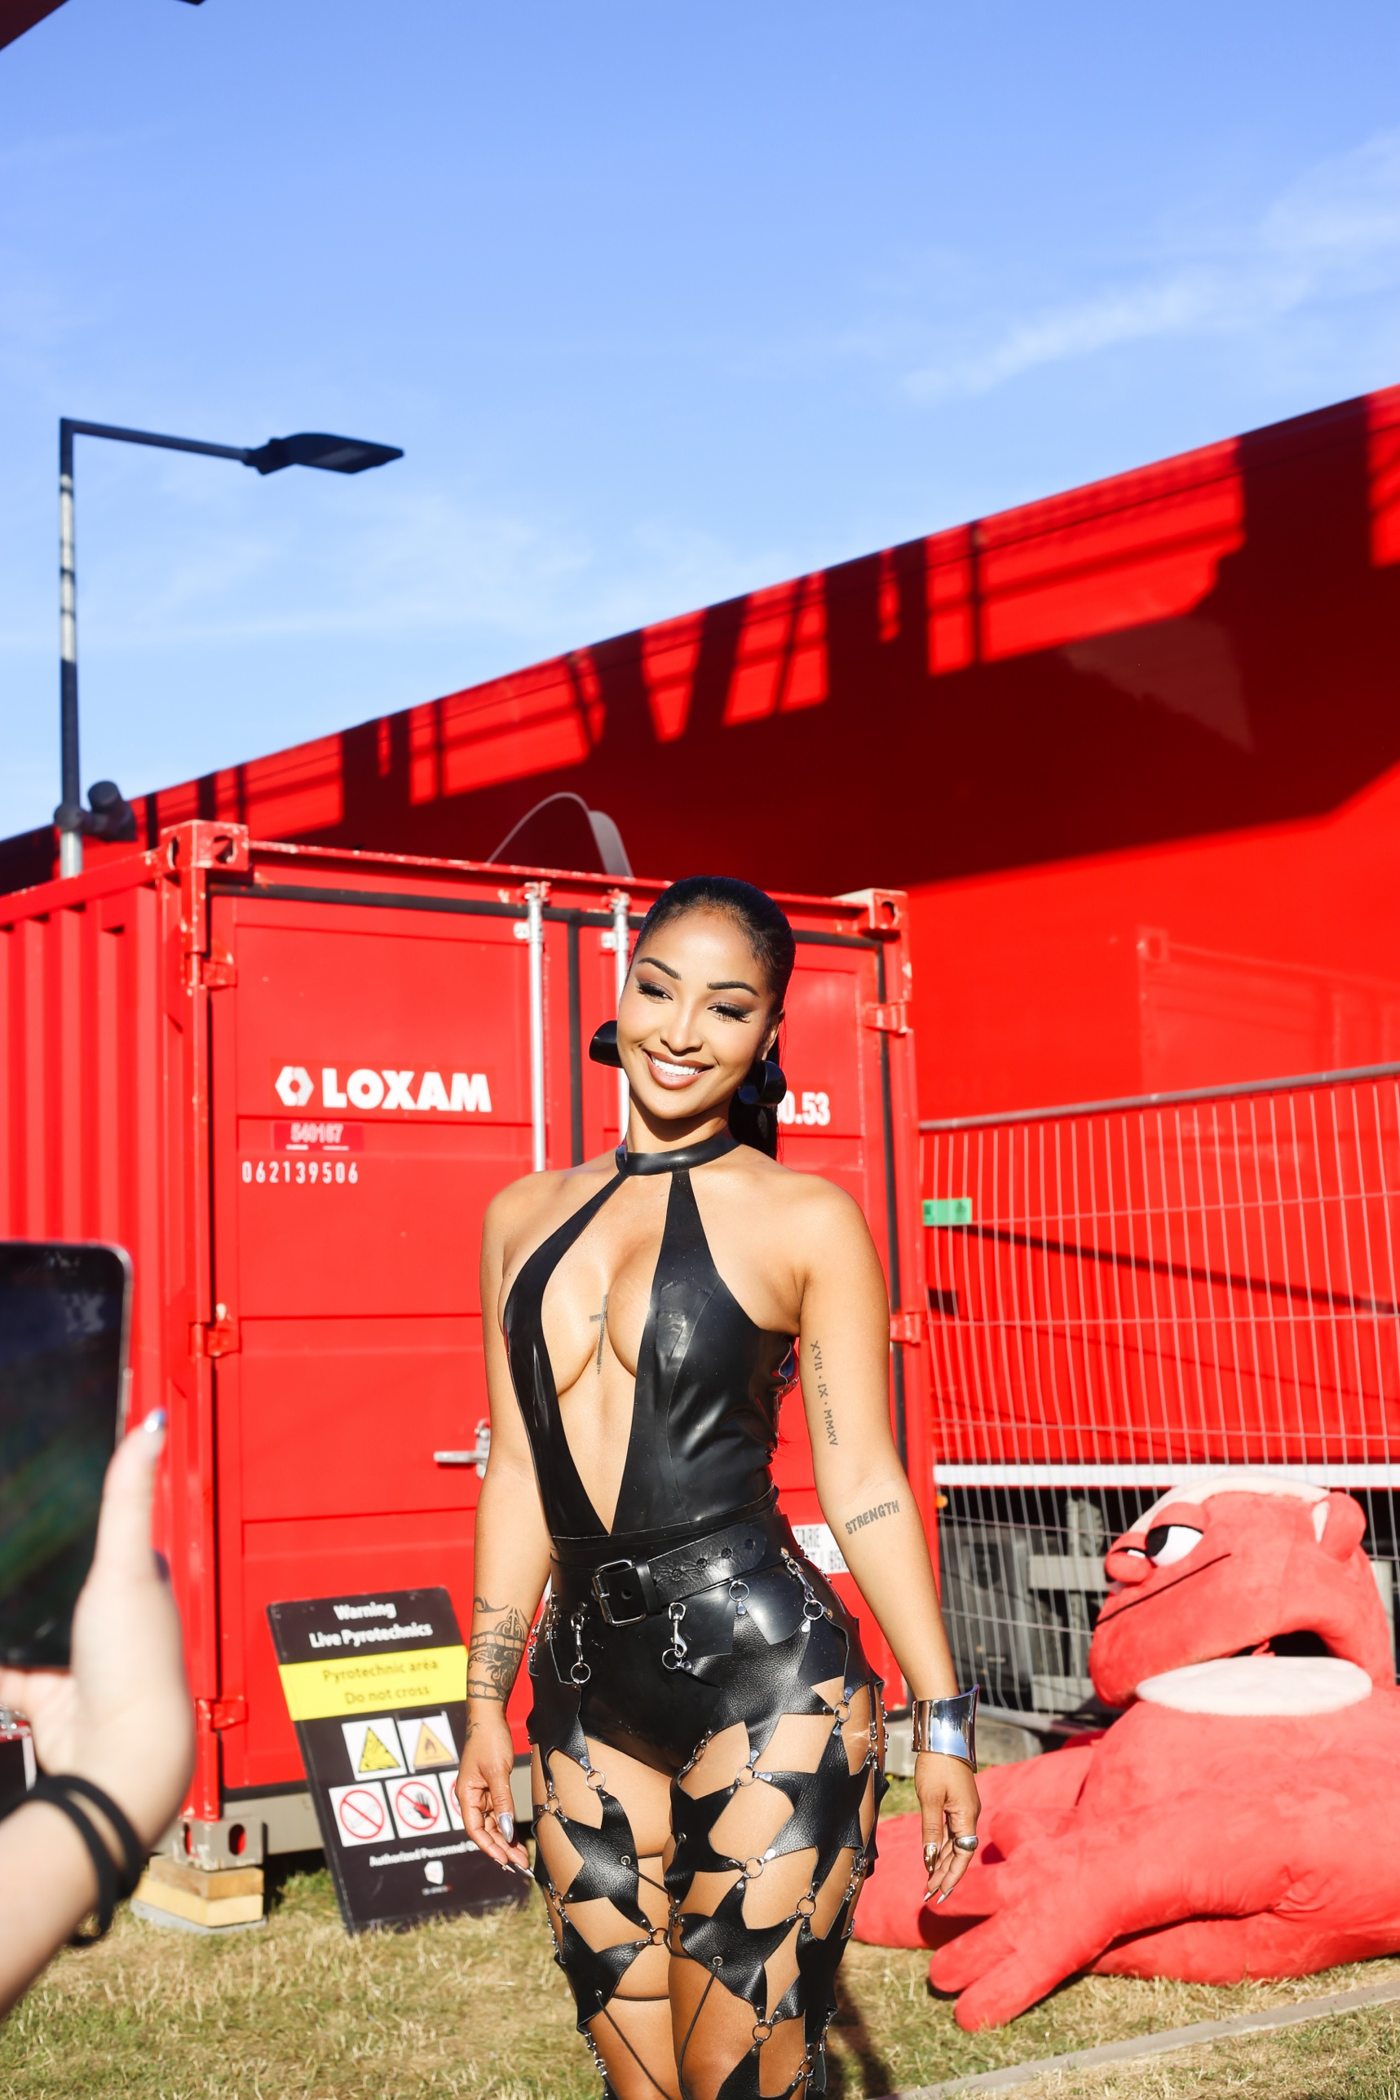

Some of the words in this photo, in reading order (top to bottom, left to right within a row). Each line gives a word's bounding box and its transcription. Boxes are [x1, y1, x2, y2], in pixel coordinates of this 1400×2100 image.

[322, 1067, 492, 1113] LOXAM
[241, 1160, 359, 1185] 062139506
[810, 1339, 823, 1372] XVII
[817, 1383, 829, 1398] IX
[823, 1408, 839, 1446] MMXV
[845, 1499, 900, 1535] STRENGTH
[333, 1601, 397, 1620] Warning
[308, 1631, 342, 1648] Live
[340, 1621, 433, 1647] Pyrotechnics
[322, 1664, 405, 1684] Pyrotechnic
[410, 1660, 438, 1673] area
[344, 1691, 365, 1704] Do
[368, 1689, 392, 1701] not
[395, 1686, 430, 1698] cross
